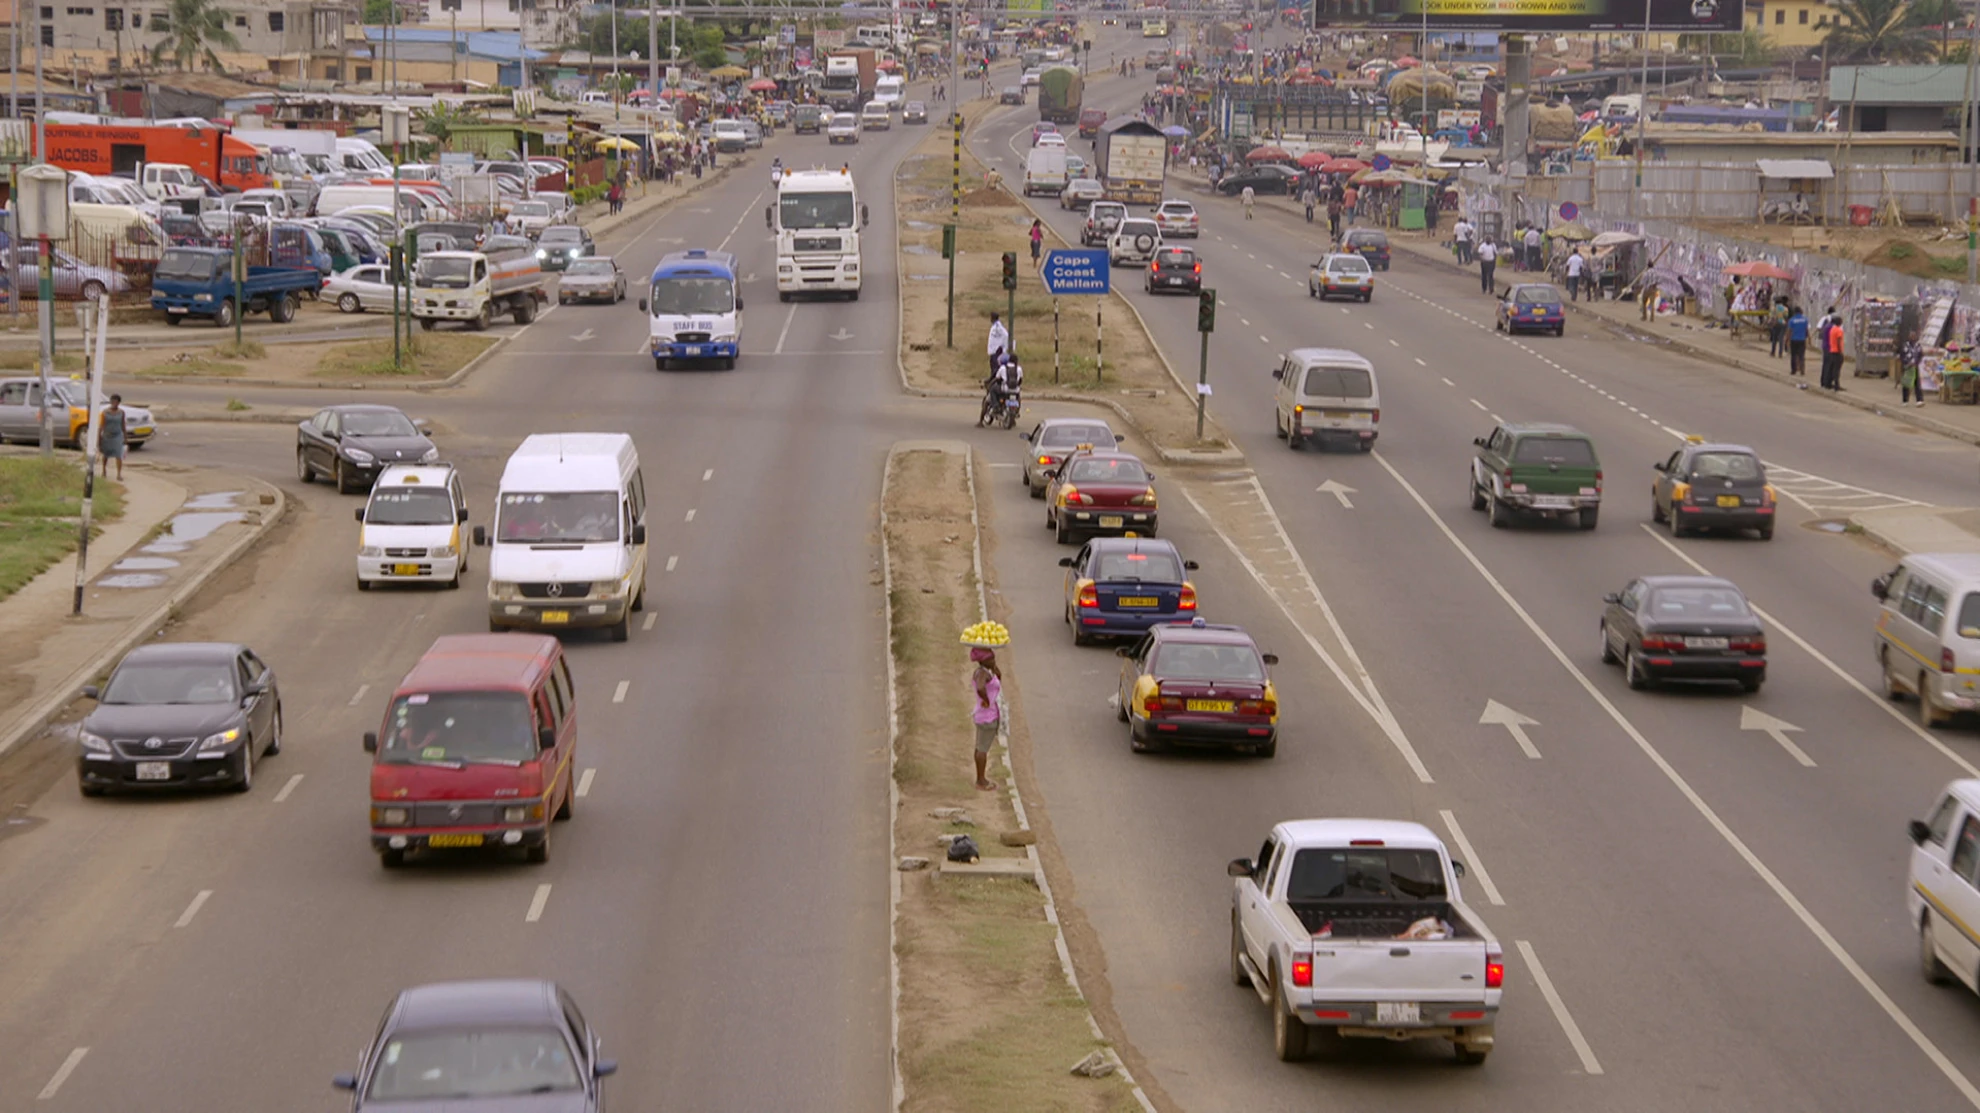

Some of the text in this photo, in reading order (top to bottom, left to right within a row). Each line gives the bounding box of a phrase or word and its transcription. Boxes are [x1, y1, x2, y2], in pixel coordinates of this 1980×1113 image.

[1444, 2, 1473, 10] UNDER
[1474, 2, 1497, 10] YOUR
[1498, 2, 1515, 10] RED
[1516, 2, 1548, 10] CROWN
[1547, 2, 1567, 10] AND
[1568, 2, 1586, 10] WIN
[44, 129, 93, 139] DUSTRIELE
[48, 147, 98, 162] JACOBS
[1053, 255, 1090, 267] Cape
[1053, 267, 1095, 277] Coast
[1053, 279, 1104, 288] Mallam
[673, 321, 713, 330] STAFF BUS
